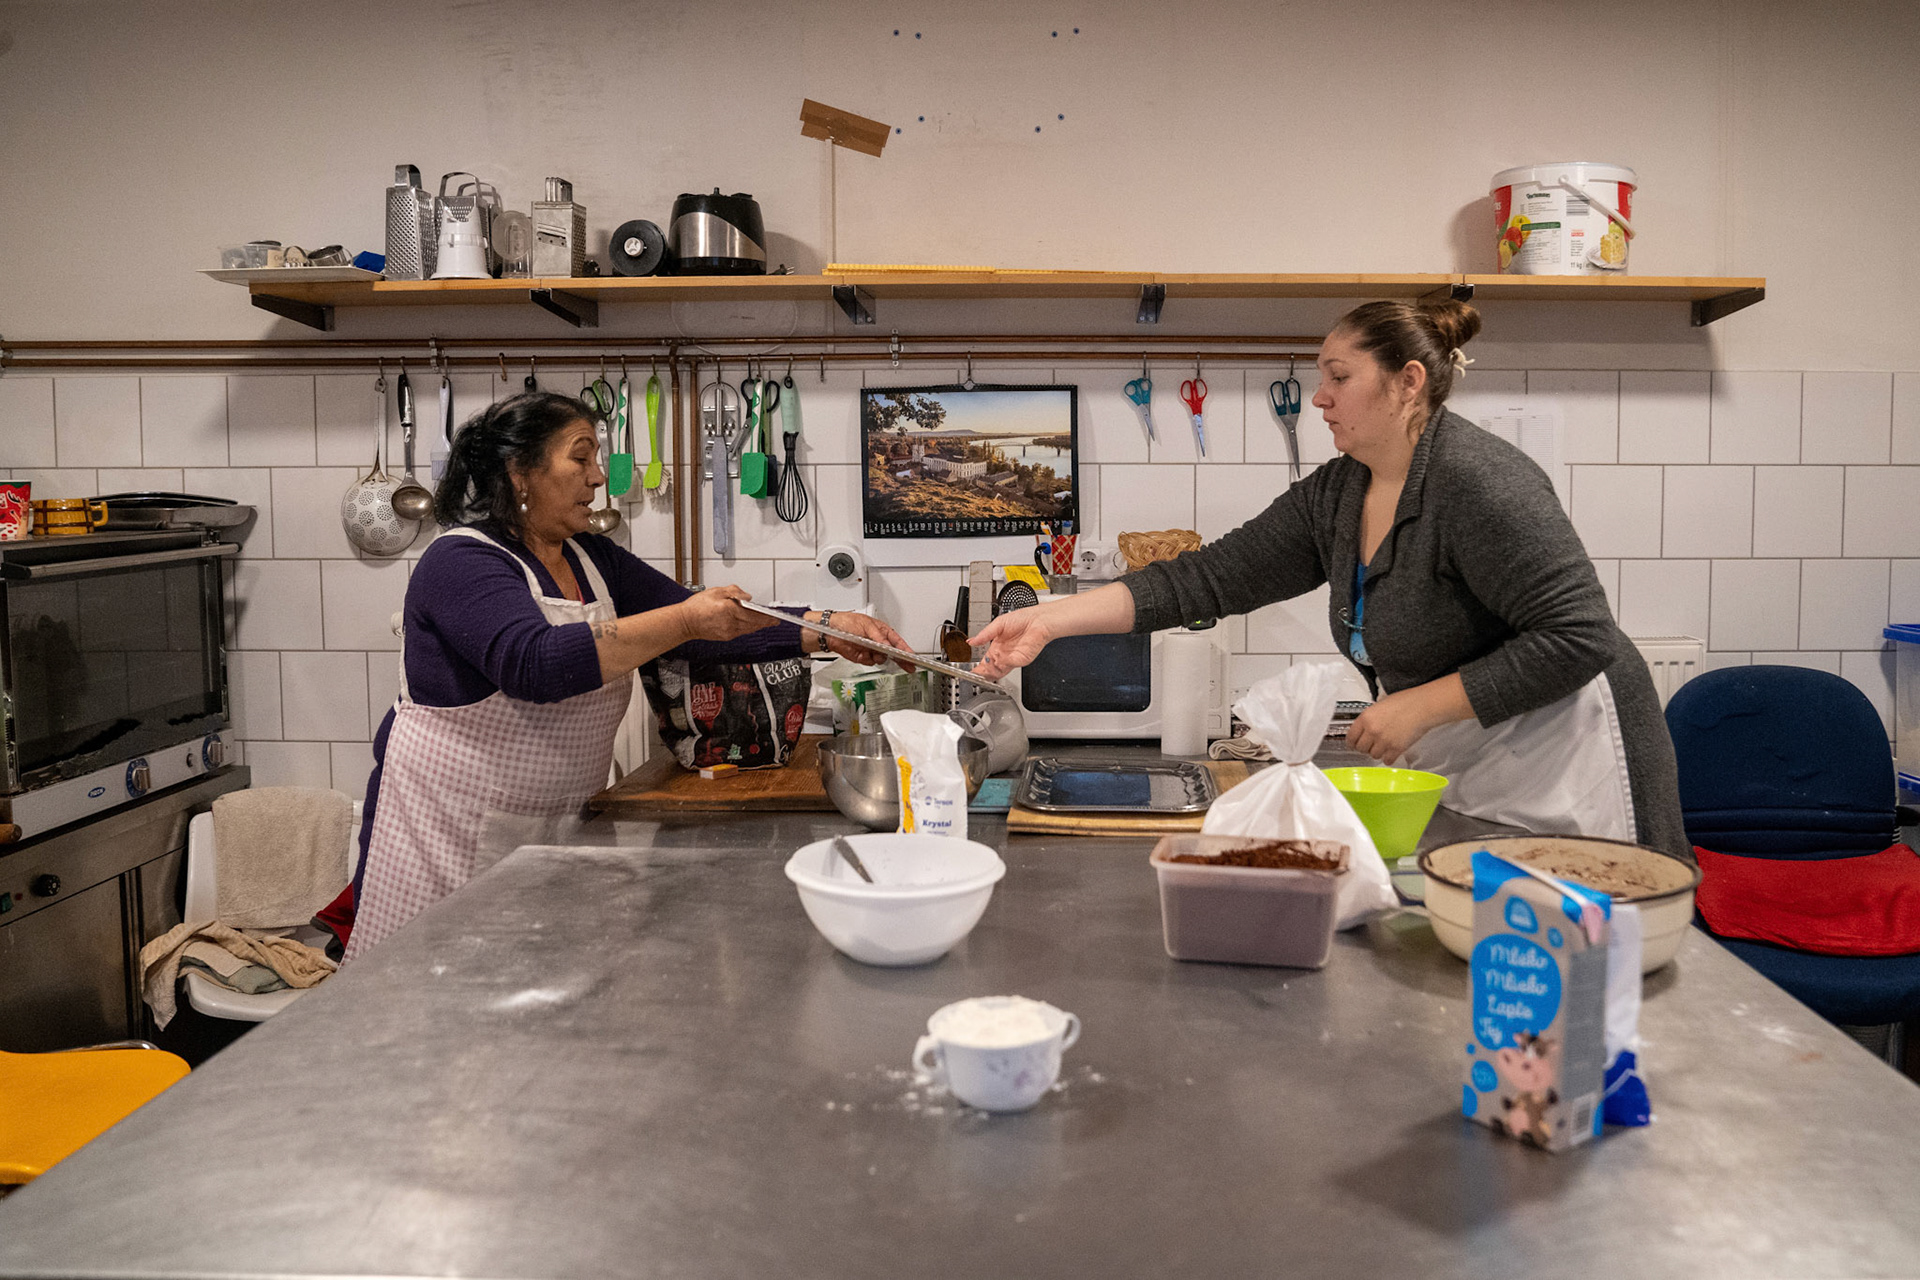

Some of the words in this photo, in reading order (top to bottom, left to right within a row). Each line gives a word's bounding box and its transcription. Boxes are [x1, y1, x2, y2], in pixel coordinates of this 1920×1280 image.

[764, 659, 794, 675] Wine
[766, 664, 801, 685] CLUB
[922, 819, 952, 829] Krystal
